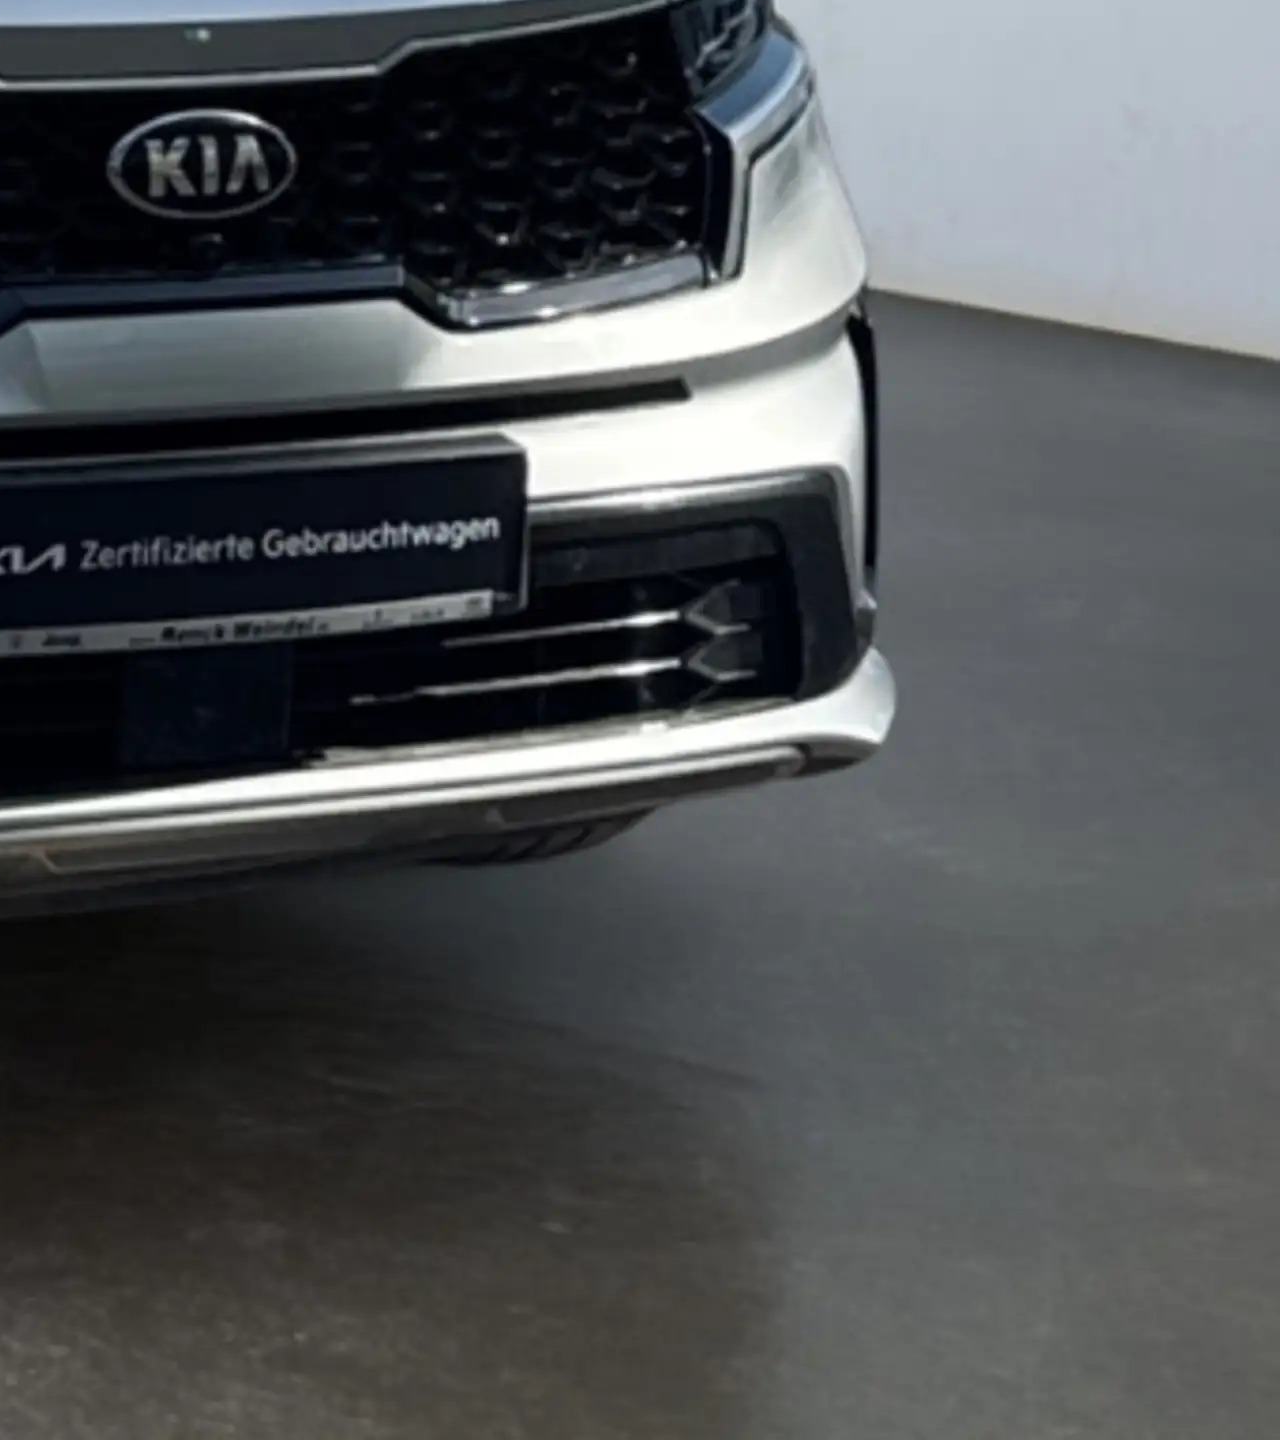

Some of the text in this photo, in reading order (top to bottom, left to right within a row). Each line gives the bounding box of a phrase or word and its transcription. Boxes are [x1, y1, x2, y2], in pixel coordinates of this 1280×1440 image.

[144, 134, 270, 197] KIA
[80, 534, 255, 570] Zertifizierte
[262, 516, 500, 558] Gebrauchtwagen
